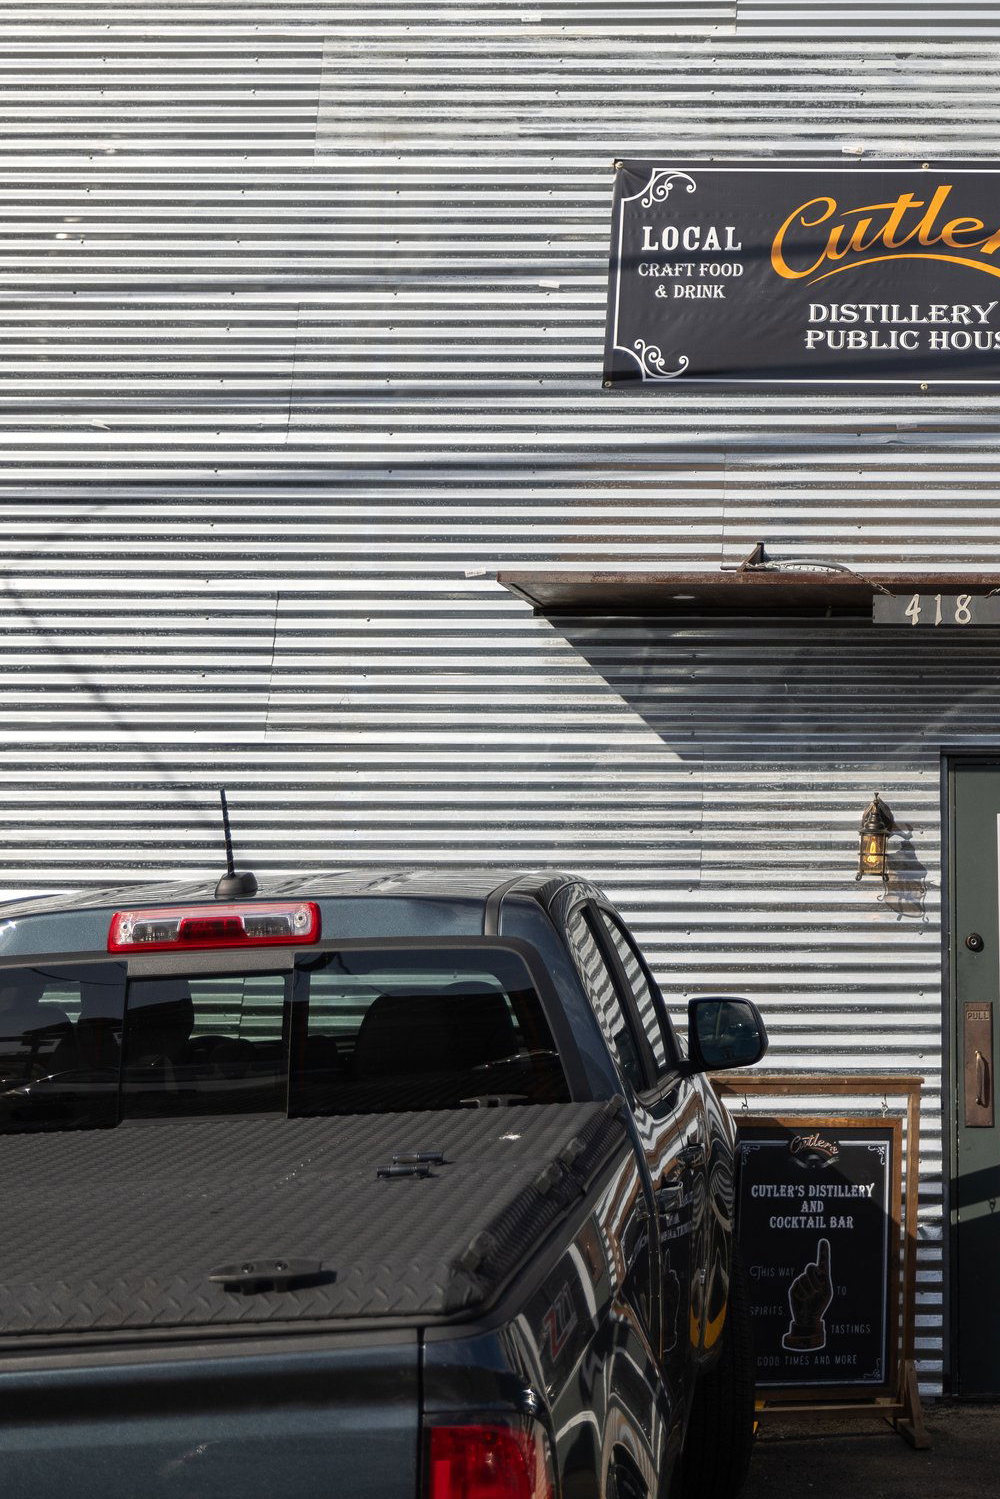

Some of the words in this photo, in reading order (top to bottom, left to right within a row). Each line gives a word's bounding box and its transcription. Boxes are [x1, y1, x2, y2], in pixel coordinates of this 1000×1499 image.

[641, 226, 742, 251] LOCAL
[638, 263, 696, 277] CRAFT
[699, 263, 744, 277] FOOD
[655, 285, 667, 298] &
[674, 285, 726, 299] DRINK
[808, 301, 998, 324] DISTILLERY
[804, 330, 920, 350] PUBLIC
[905, 594, 972, 626] 418
[967, 1012, 988, 1020] PULL
[751, 1185, 805, 1198] CUTLER'S
[808, 1183, 875, 1198] DISTILLERY
[800, 1201, 825, 1213] AND
[769, 1216, 826, 1229] COCKTAIL
[830, 1216, 854, 1229] BAR
[750, 1305, 783, 1316] SPIRITS
[831, 1324, 871, 1334] TASTINGS
[785, 1357, 809, 1366] TIMES
[835, 1355, 857, 1365] MORE
